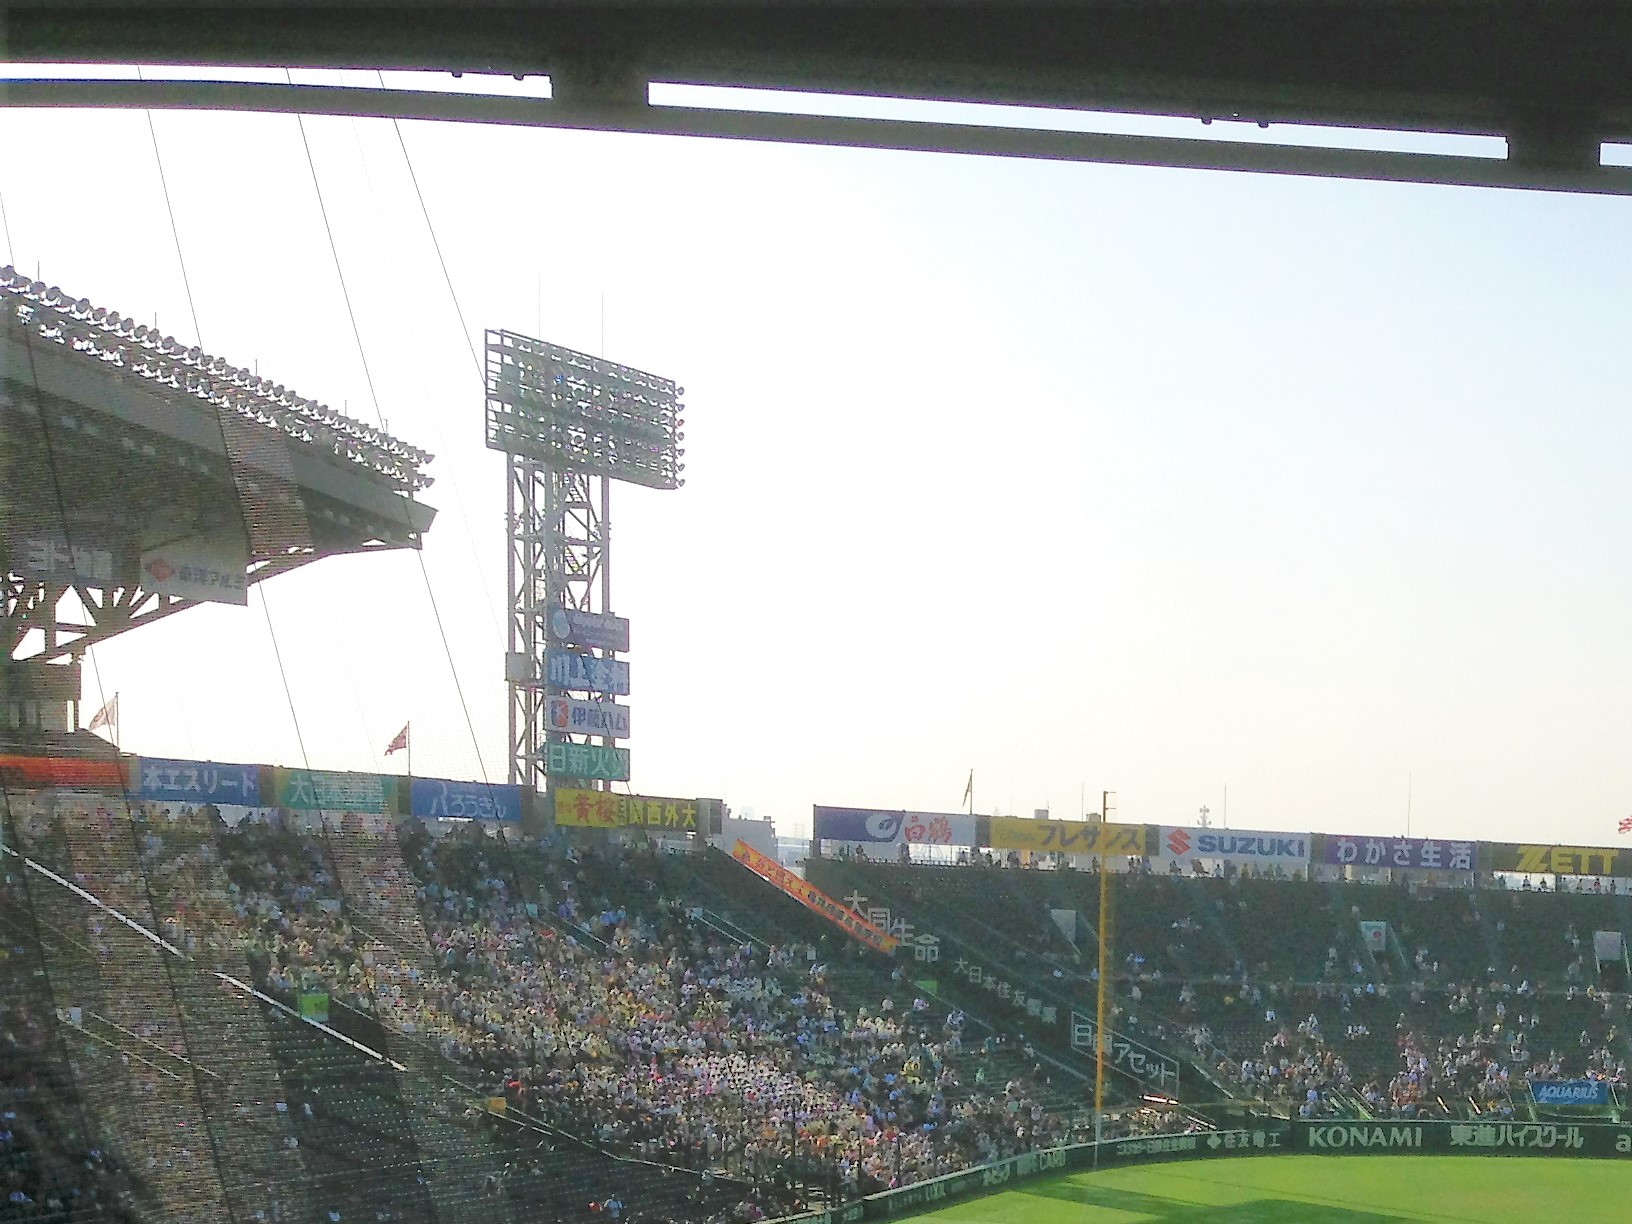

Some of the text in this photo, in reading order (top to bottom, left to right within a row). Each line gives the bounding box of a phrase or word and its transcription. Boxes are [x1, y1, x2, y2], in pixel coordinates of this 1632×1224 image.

[904, 815, 952, 844] 白鶴
[1198, 834, 1305, 858] SUZUKI
[1337, 838, 1471, 870] わかさ生活
[1516, 845, 1619, 874] ZETT
[844, 890, 940, 963] 大同生命
[1538, 1081, 1599, 1102] AQUARIUS
[1308, 1126, 1423, 1148] KONAMI
[1450, 1124, 1584, 1149] 東進ハイスクール
